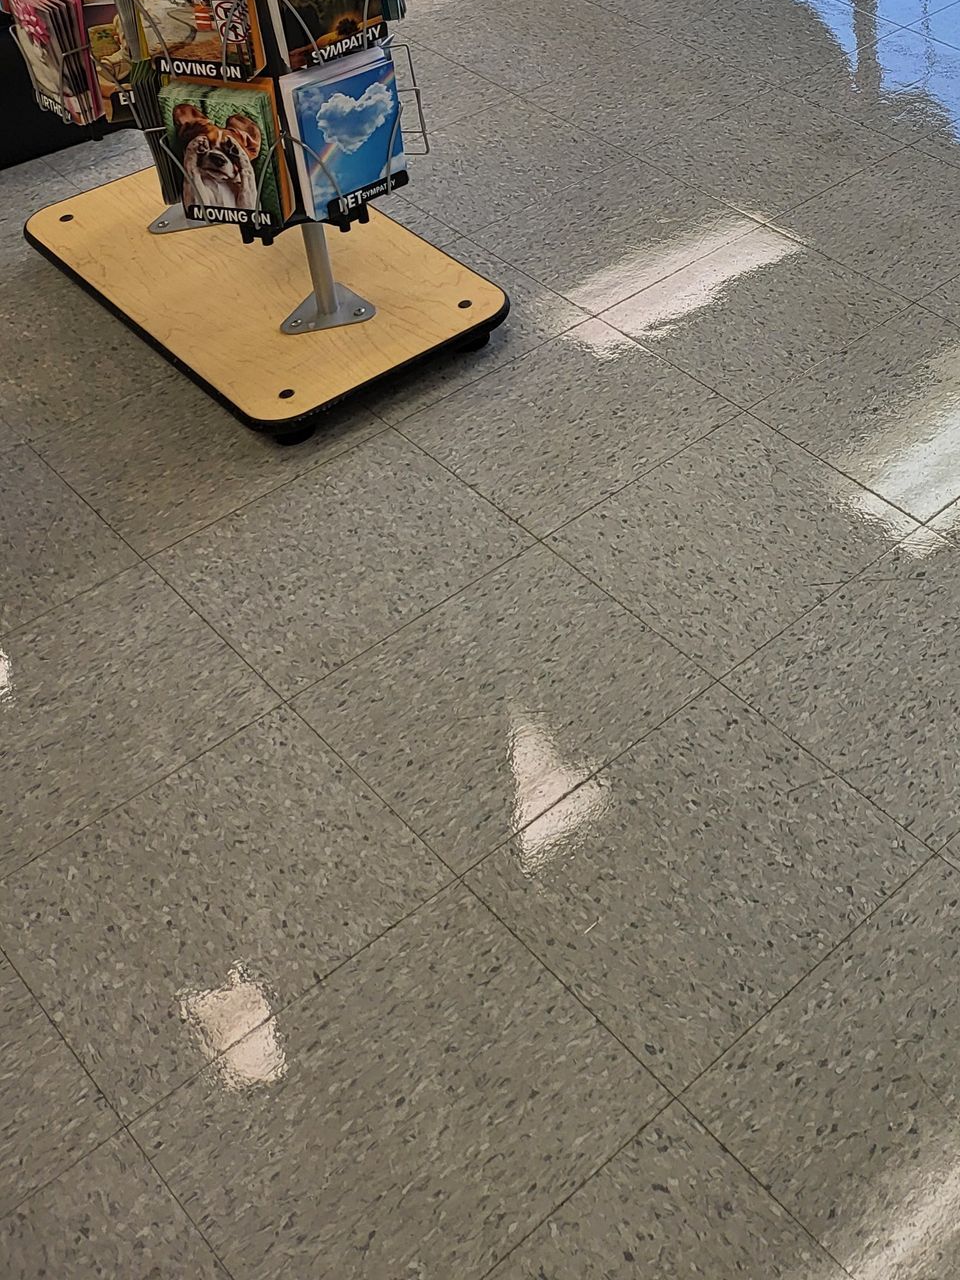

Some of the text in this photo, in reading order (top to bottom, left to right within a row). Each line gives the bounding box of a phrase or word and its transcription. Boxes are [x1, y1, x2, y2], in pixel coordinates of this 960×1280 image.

[311, 24, 381, 63] SYMPATHY
[160, 59, 241, 79] MOVING ON
[362, 179, 396, 199] SYMPATY
[193, 207, 271, 226] MOVING ON
